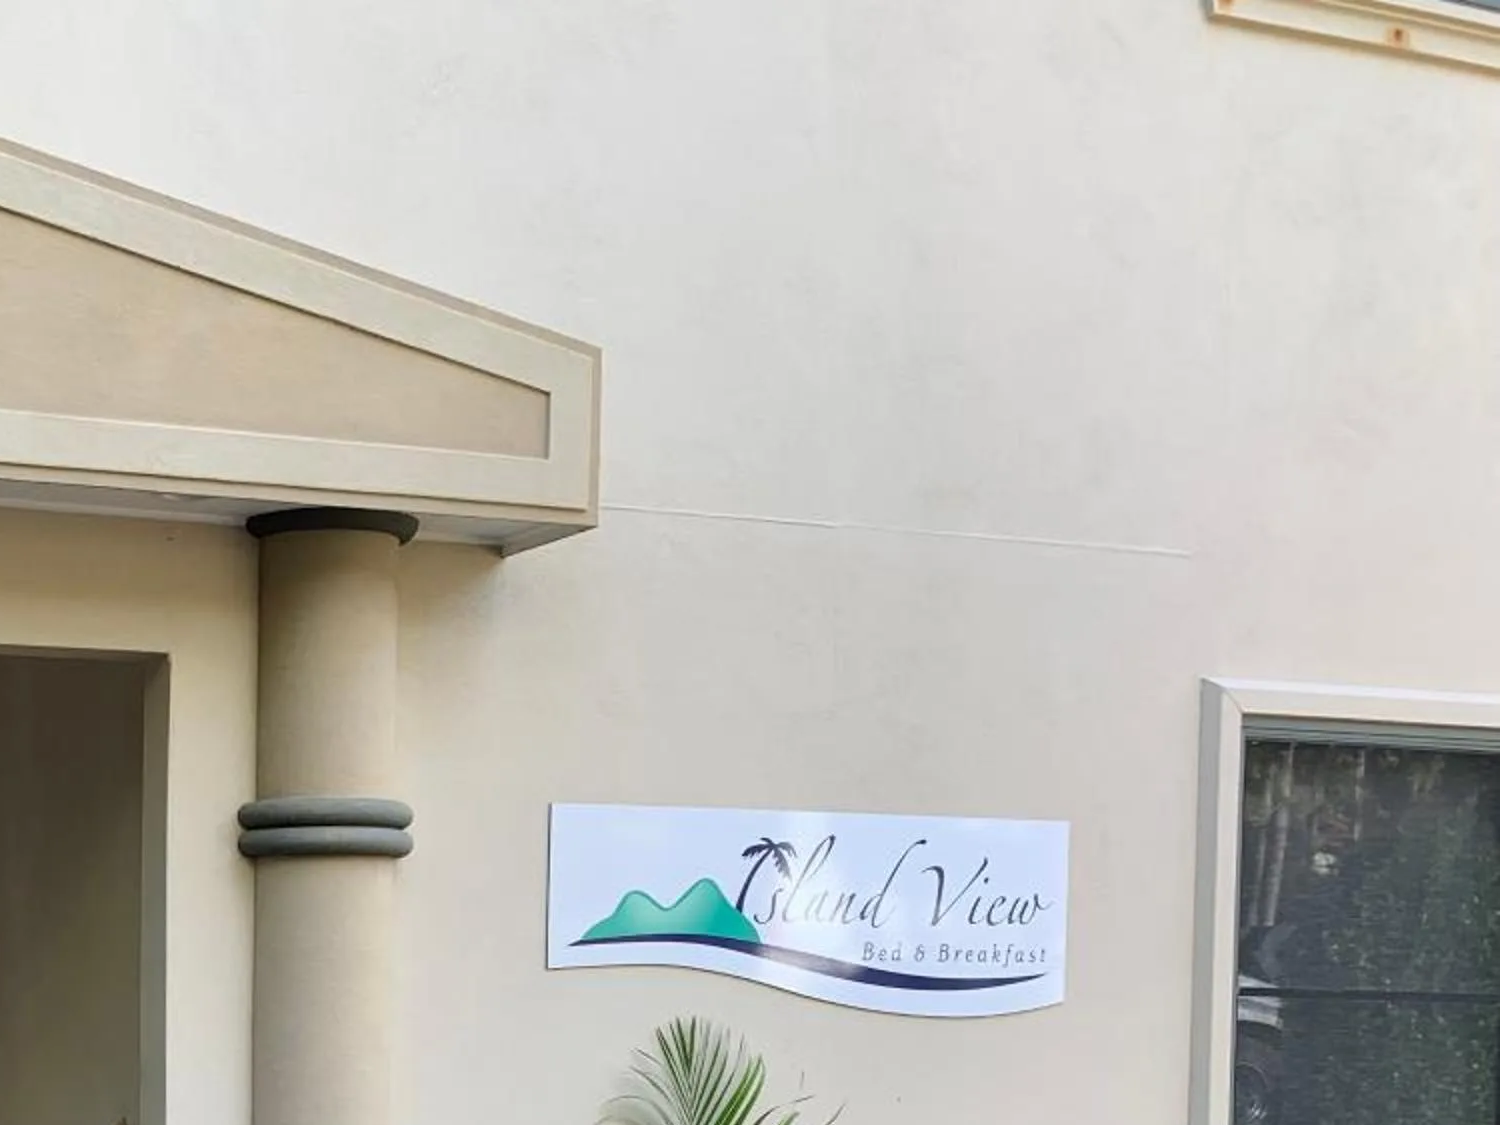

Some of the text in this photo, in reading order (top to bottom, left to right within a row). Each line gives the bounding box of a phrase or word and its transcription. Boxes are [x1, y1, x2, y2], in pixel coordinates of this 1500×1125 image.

[920, 856, 1053, 927] View
[861, 941, 1047, 967] Bed & Breakfast
